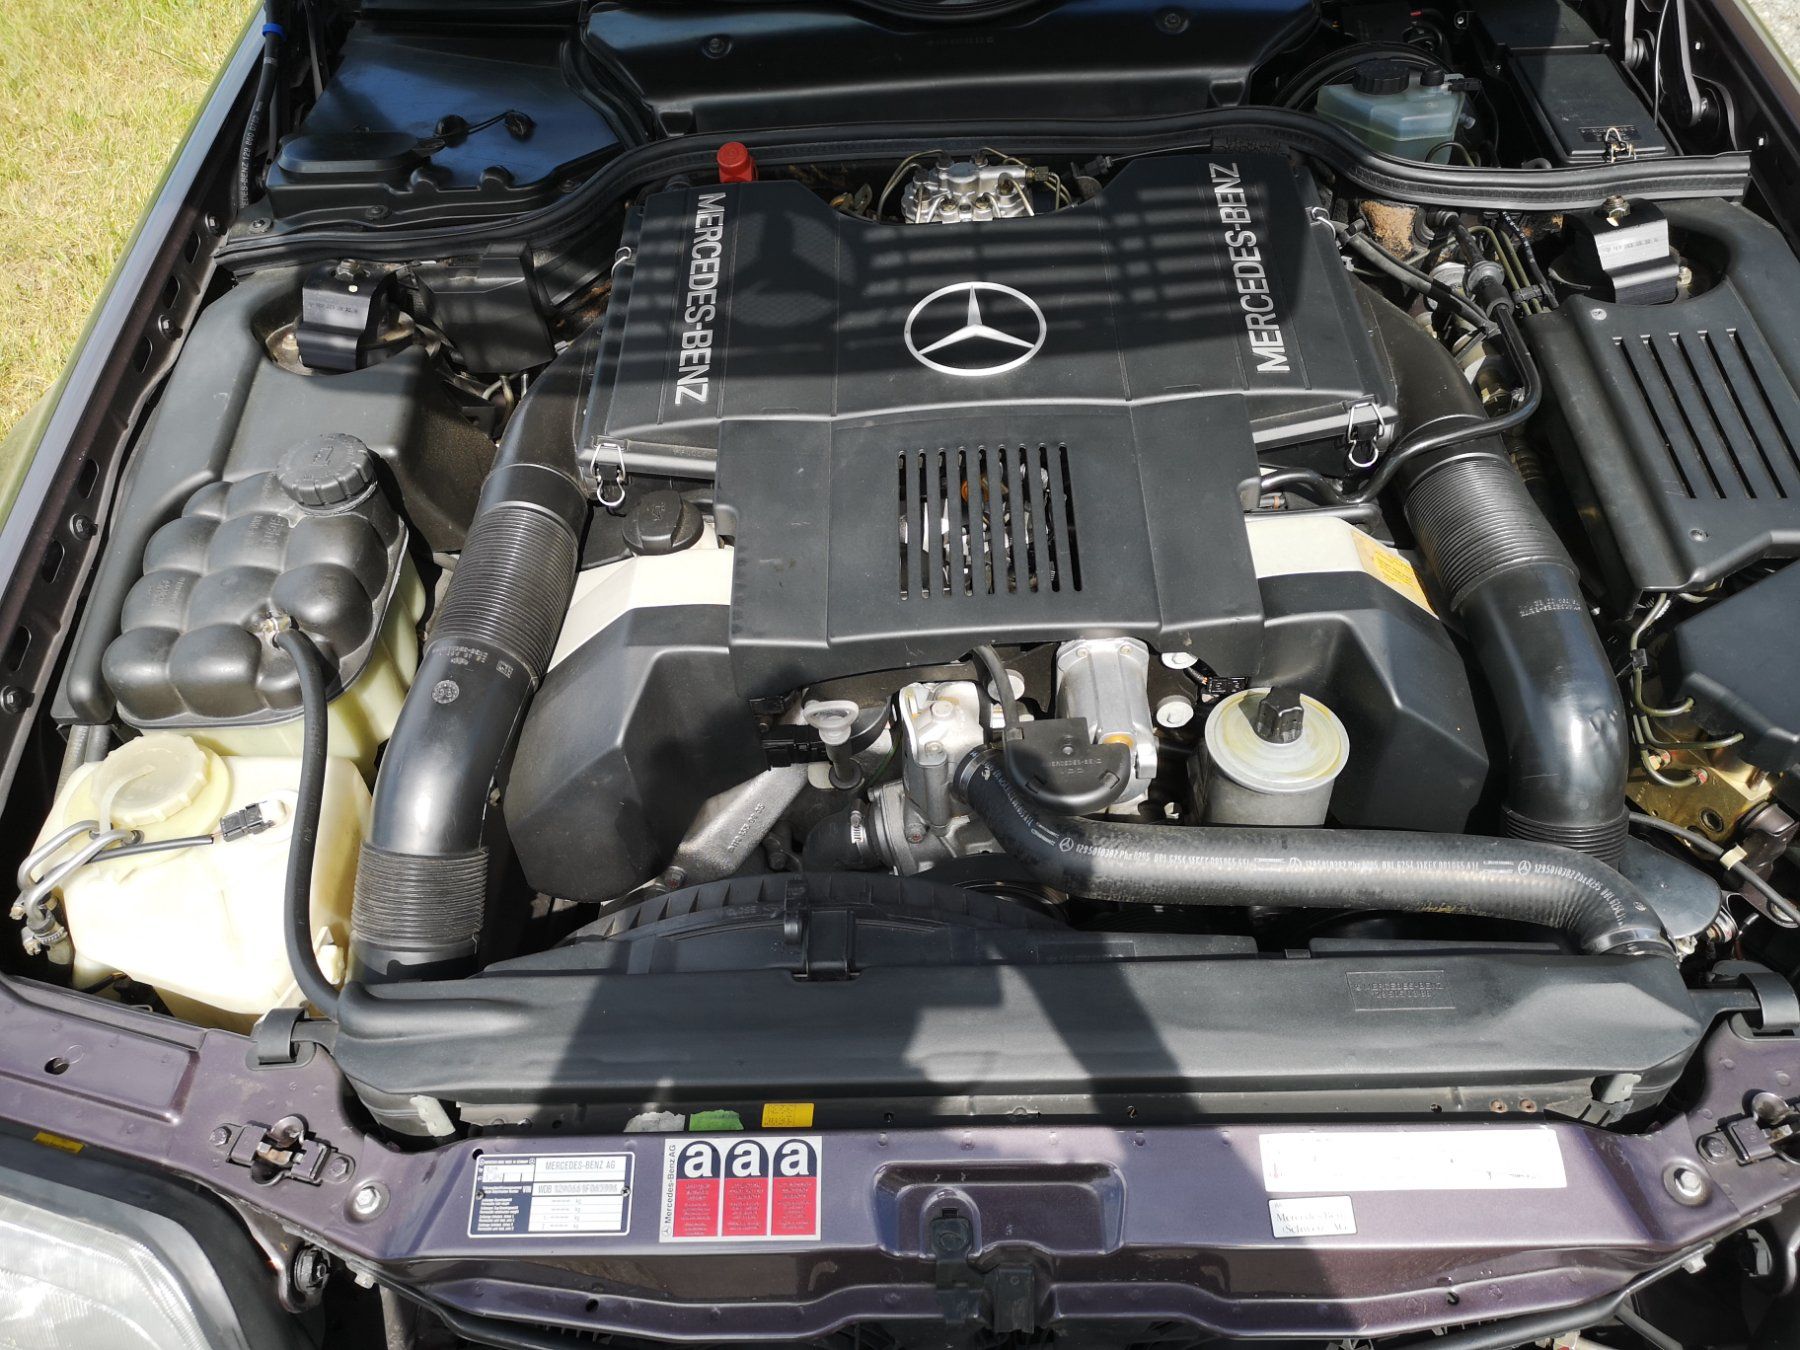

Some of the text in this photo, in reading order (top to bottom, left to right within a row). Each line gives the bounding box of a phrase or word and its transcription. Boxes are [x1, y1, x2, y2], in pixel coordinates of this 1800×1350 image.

[675, 192, 726, 405] MERCEDES-BENZ
[1209, 163, 1290, 373] MERCEDES-BENZ
[545, 1159, 616, 1170] MERCEDES-BENZ AG
[665, 1144, 677, 1224] Mercedes-Benz AG
[684, 1142, 810, 1178] a a a
